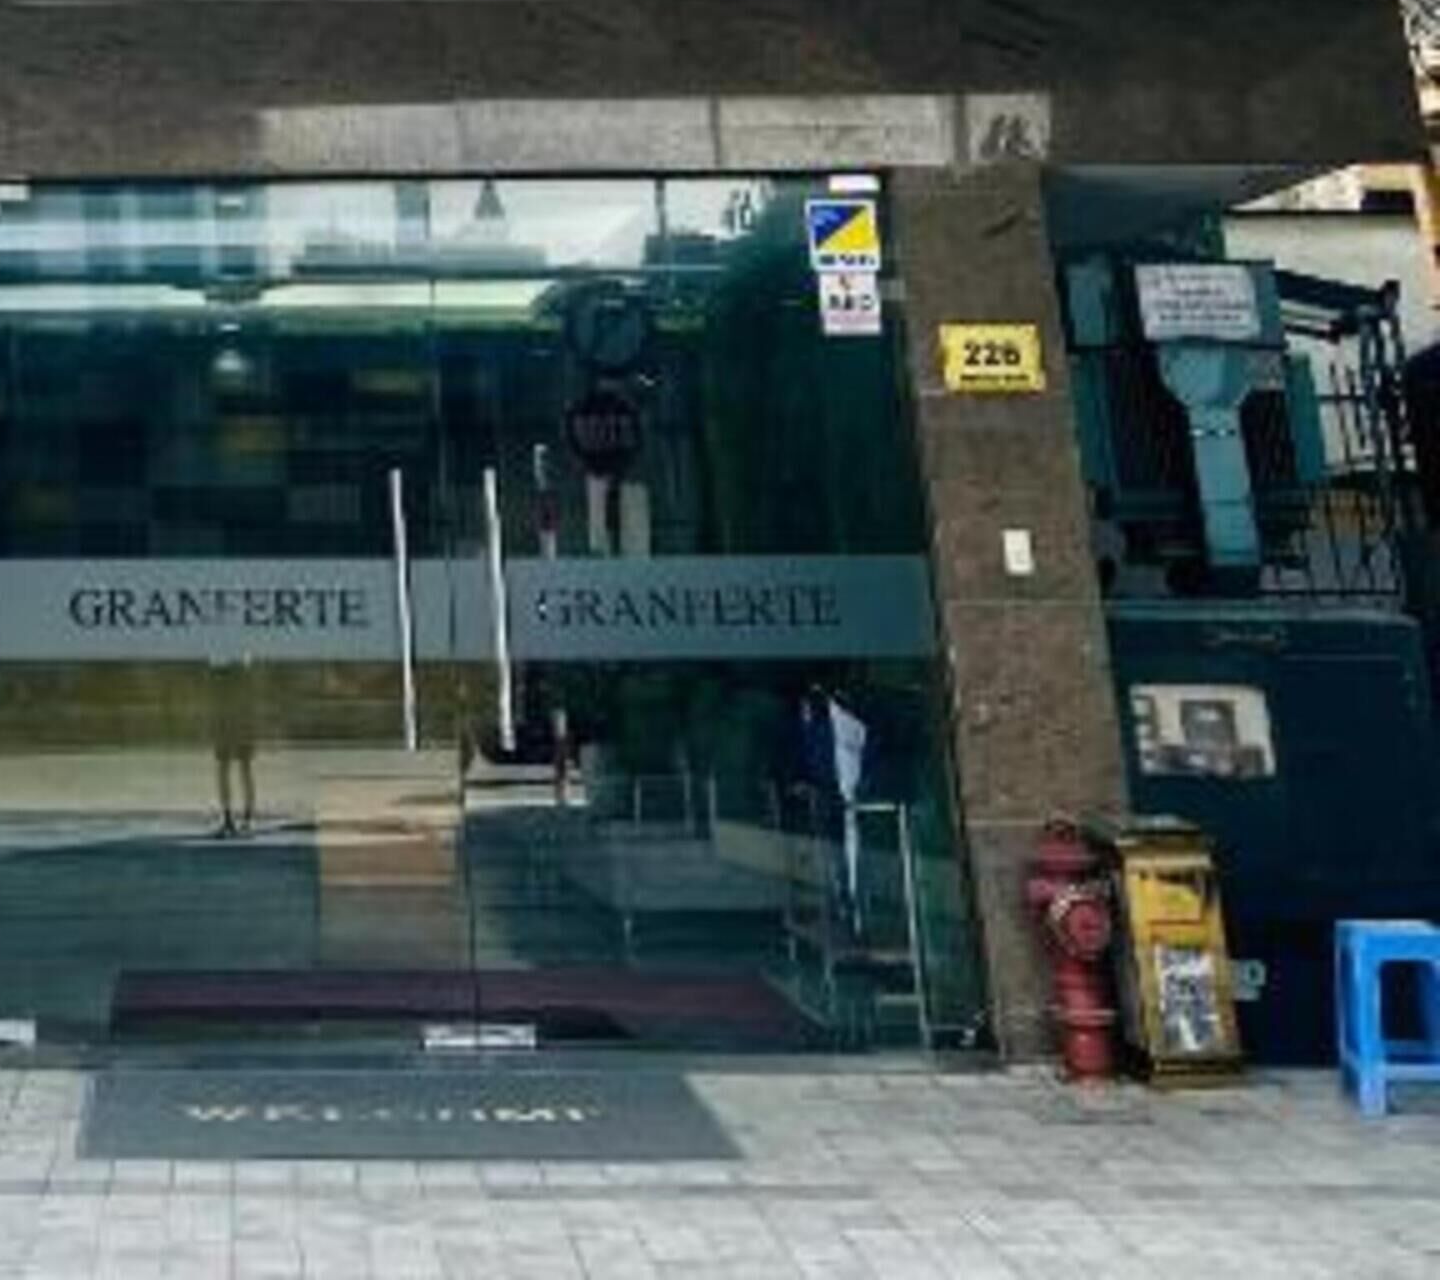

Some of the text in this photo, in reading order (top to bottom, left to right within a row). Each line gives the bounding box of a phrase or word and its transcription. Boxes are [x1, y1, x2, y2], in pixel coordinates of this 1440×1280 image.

[963, 339, 1022, 367] 226
[68, 588, 370, 628] GRANFERTE
[534, 586, 840, 627] GRANFERTE
